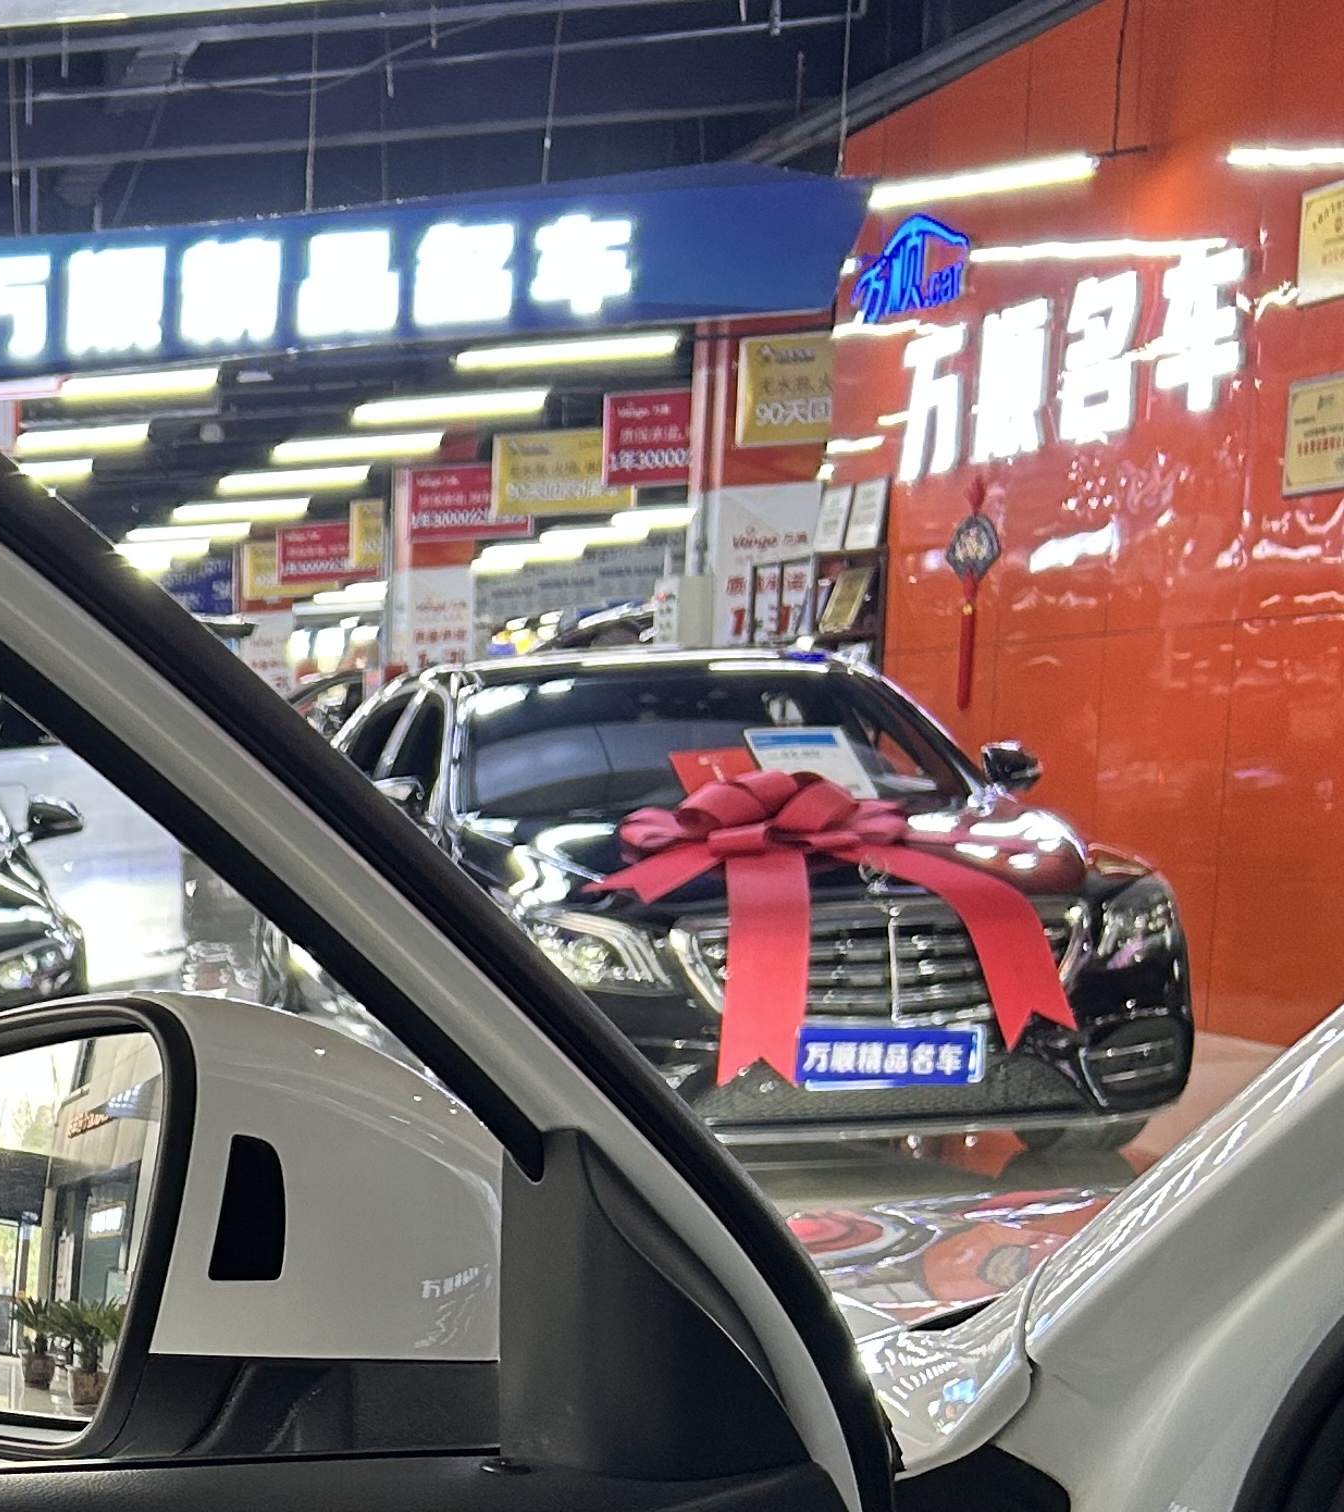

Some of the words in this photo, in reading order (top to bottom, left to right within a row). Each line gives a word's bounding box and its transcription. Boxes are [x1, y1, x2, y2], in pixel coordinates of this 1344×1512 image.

[802, 1041, 964, 1076] 万顺精品名车
